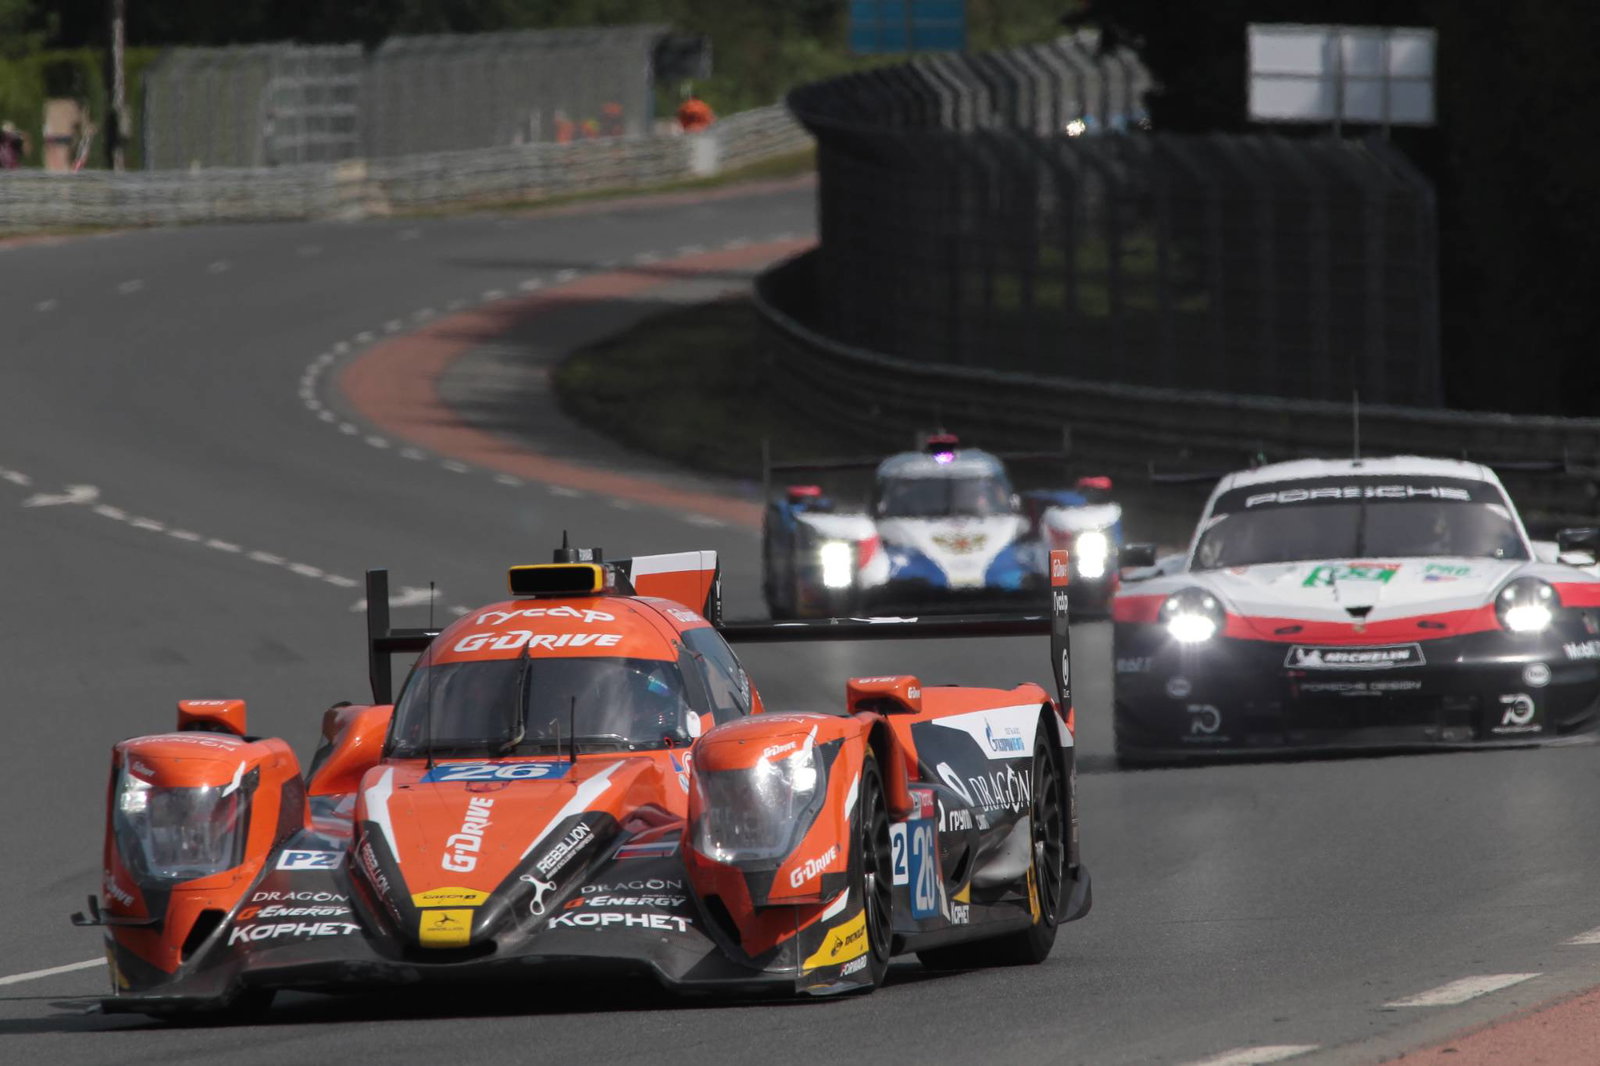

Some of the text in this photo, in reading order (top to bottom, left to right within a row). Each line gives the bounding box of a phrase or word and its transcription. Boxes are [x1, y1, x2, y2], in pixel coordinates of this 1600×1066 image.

[1246, 485, 1471, 508] PORSCHE
[440, 764, 553, 781] 26
[968, 763, 1031, 814] DRAGON
[536, 822, 591, 874] REBELLION
[283, 852, 338, 867] P2
[913, 825, 936, 911] 26
[252, 891, 349, 902] DRAGON
[581, 879, 682, 894] DRAGON
